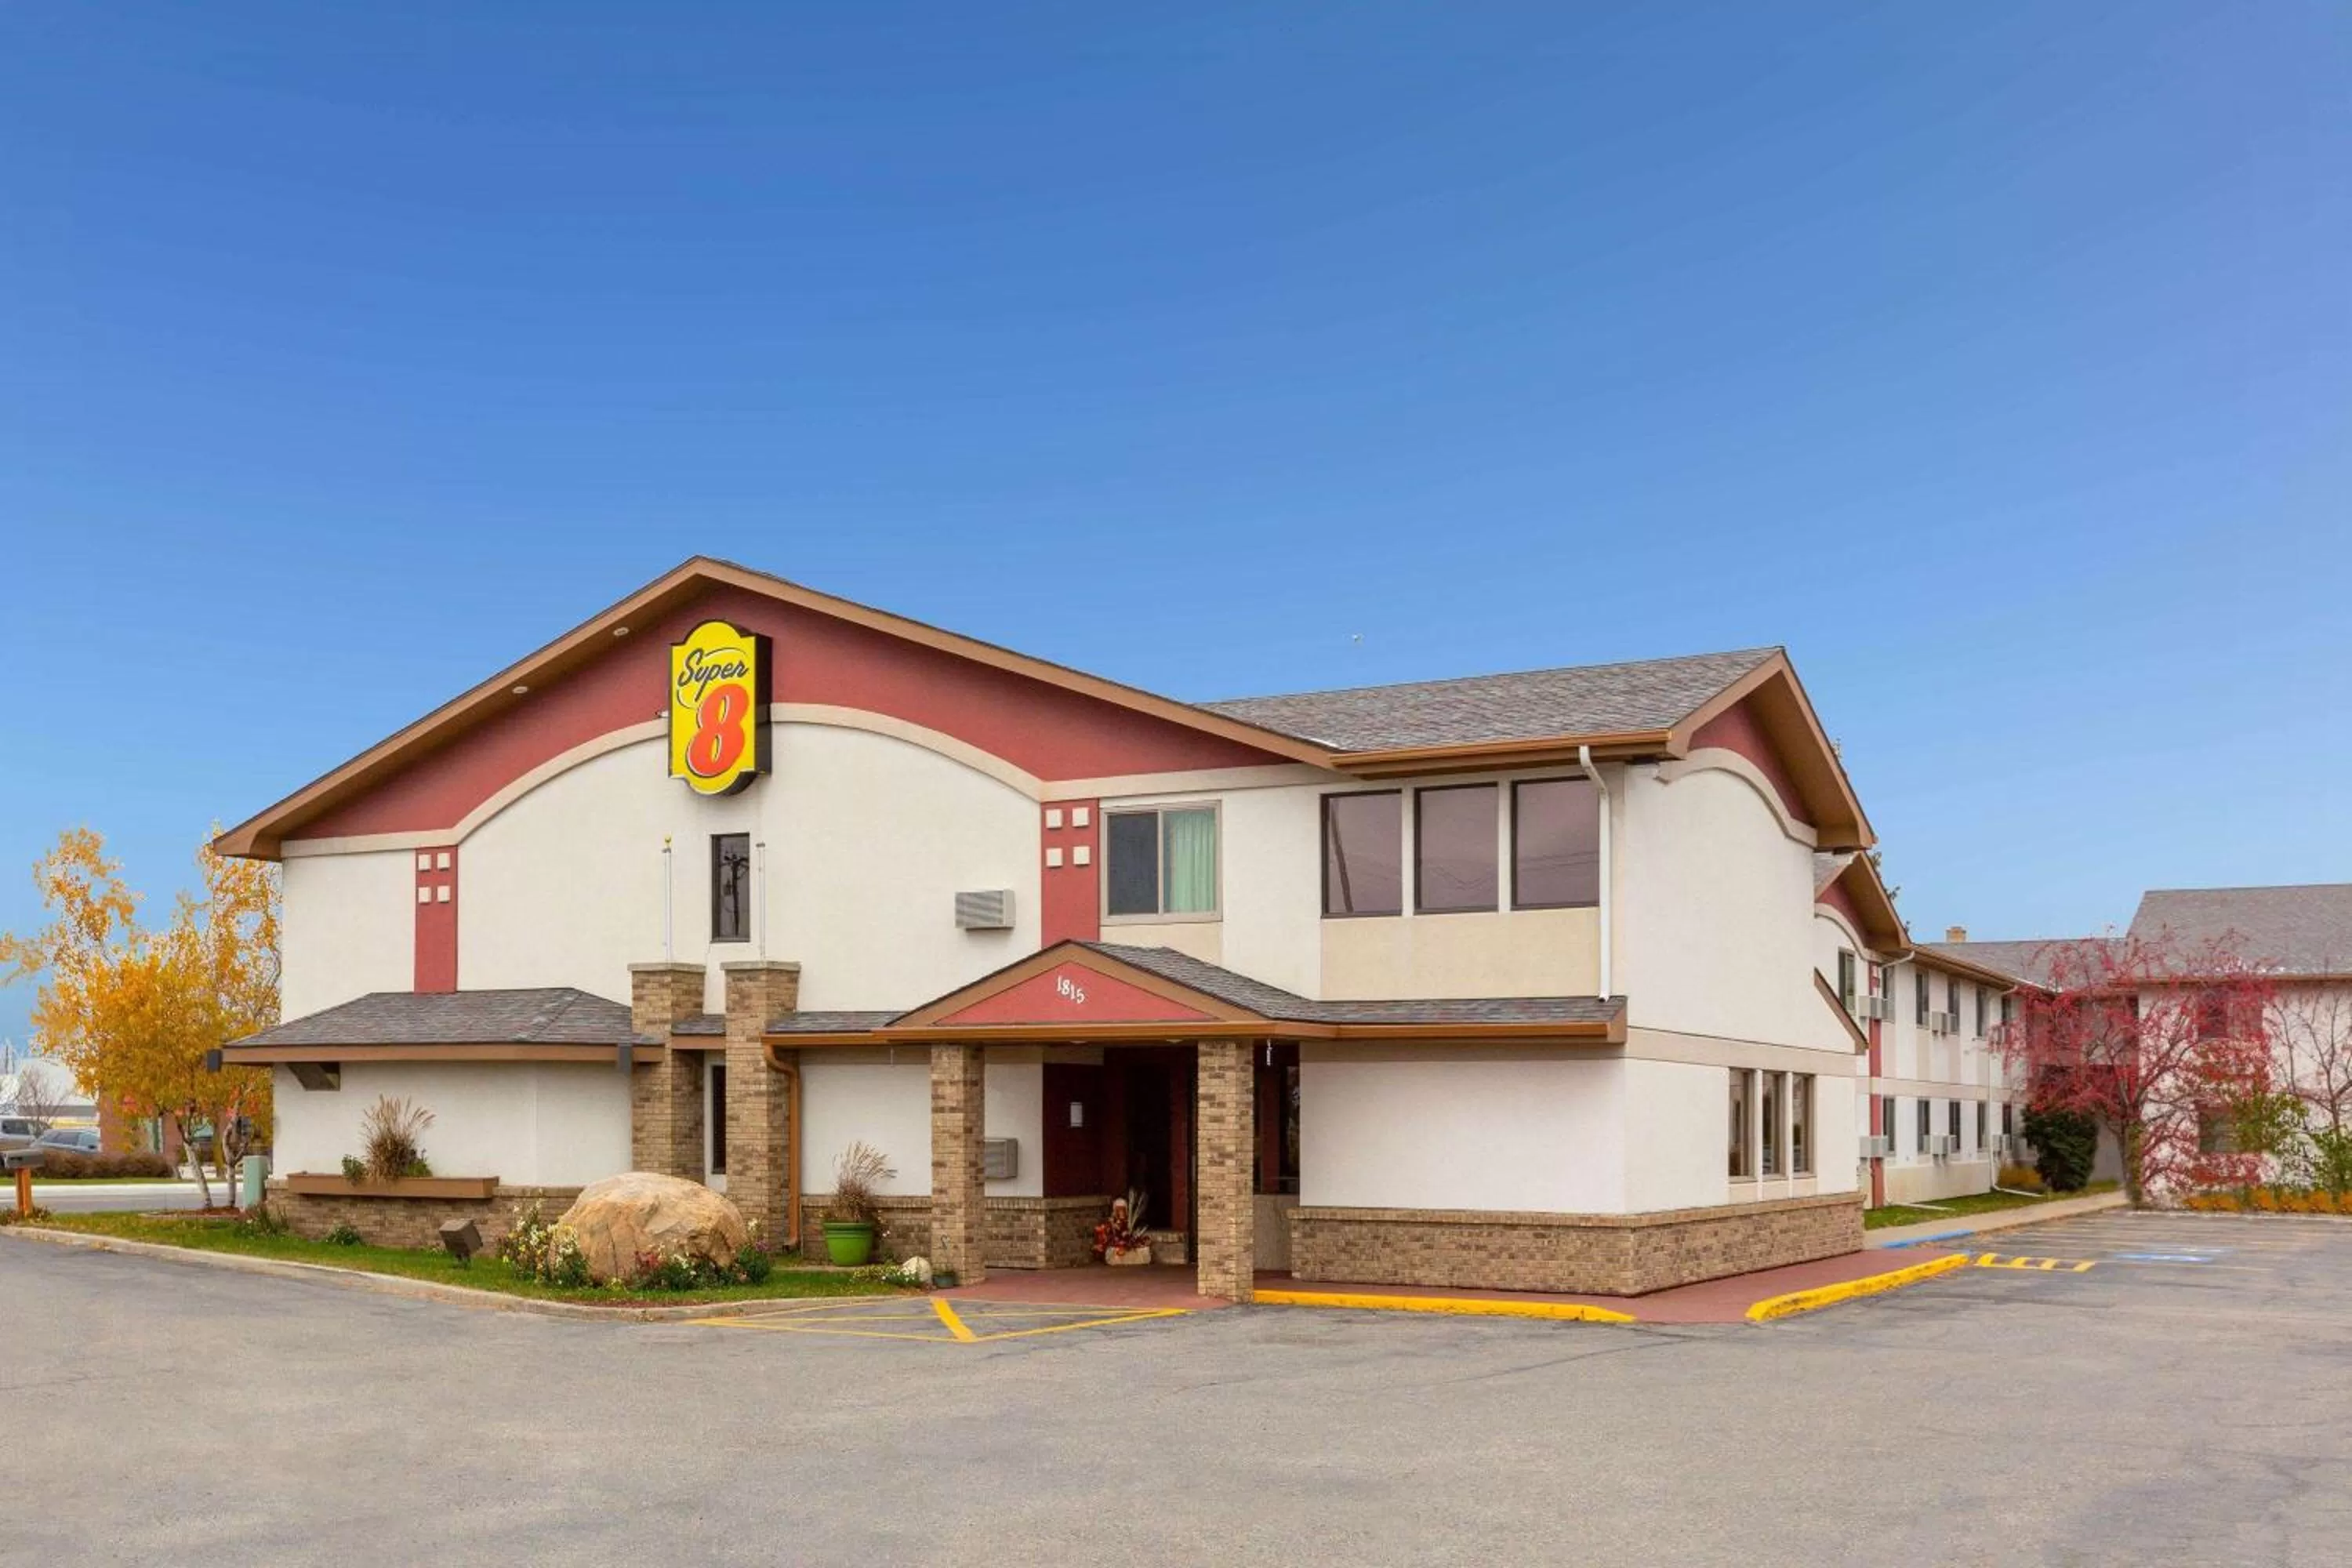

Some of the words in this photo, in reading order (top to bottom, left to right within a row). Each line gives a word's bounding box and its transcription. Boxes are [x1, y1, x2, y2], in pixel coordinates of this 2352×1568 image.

[677, 648, 749, 702] Super
[684, 683, 750, 779] 8
[1056, 975, 1085, 1004] 1815
